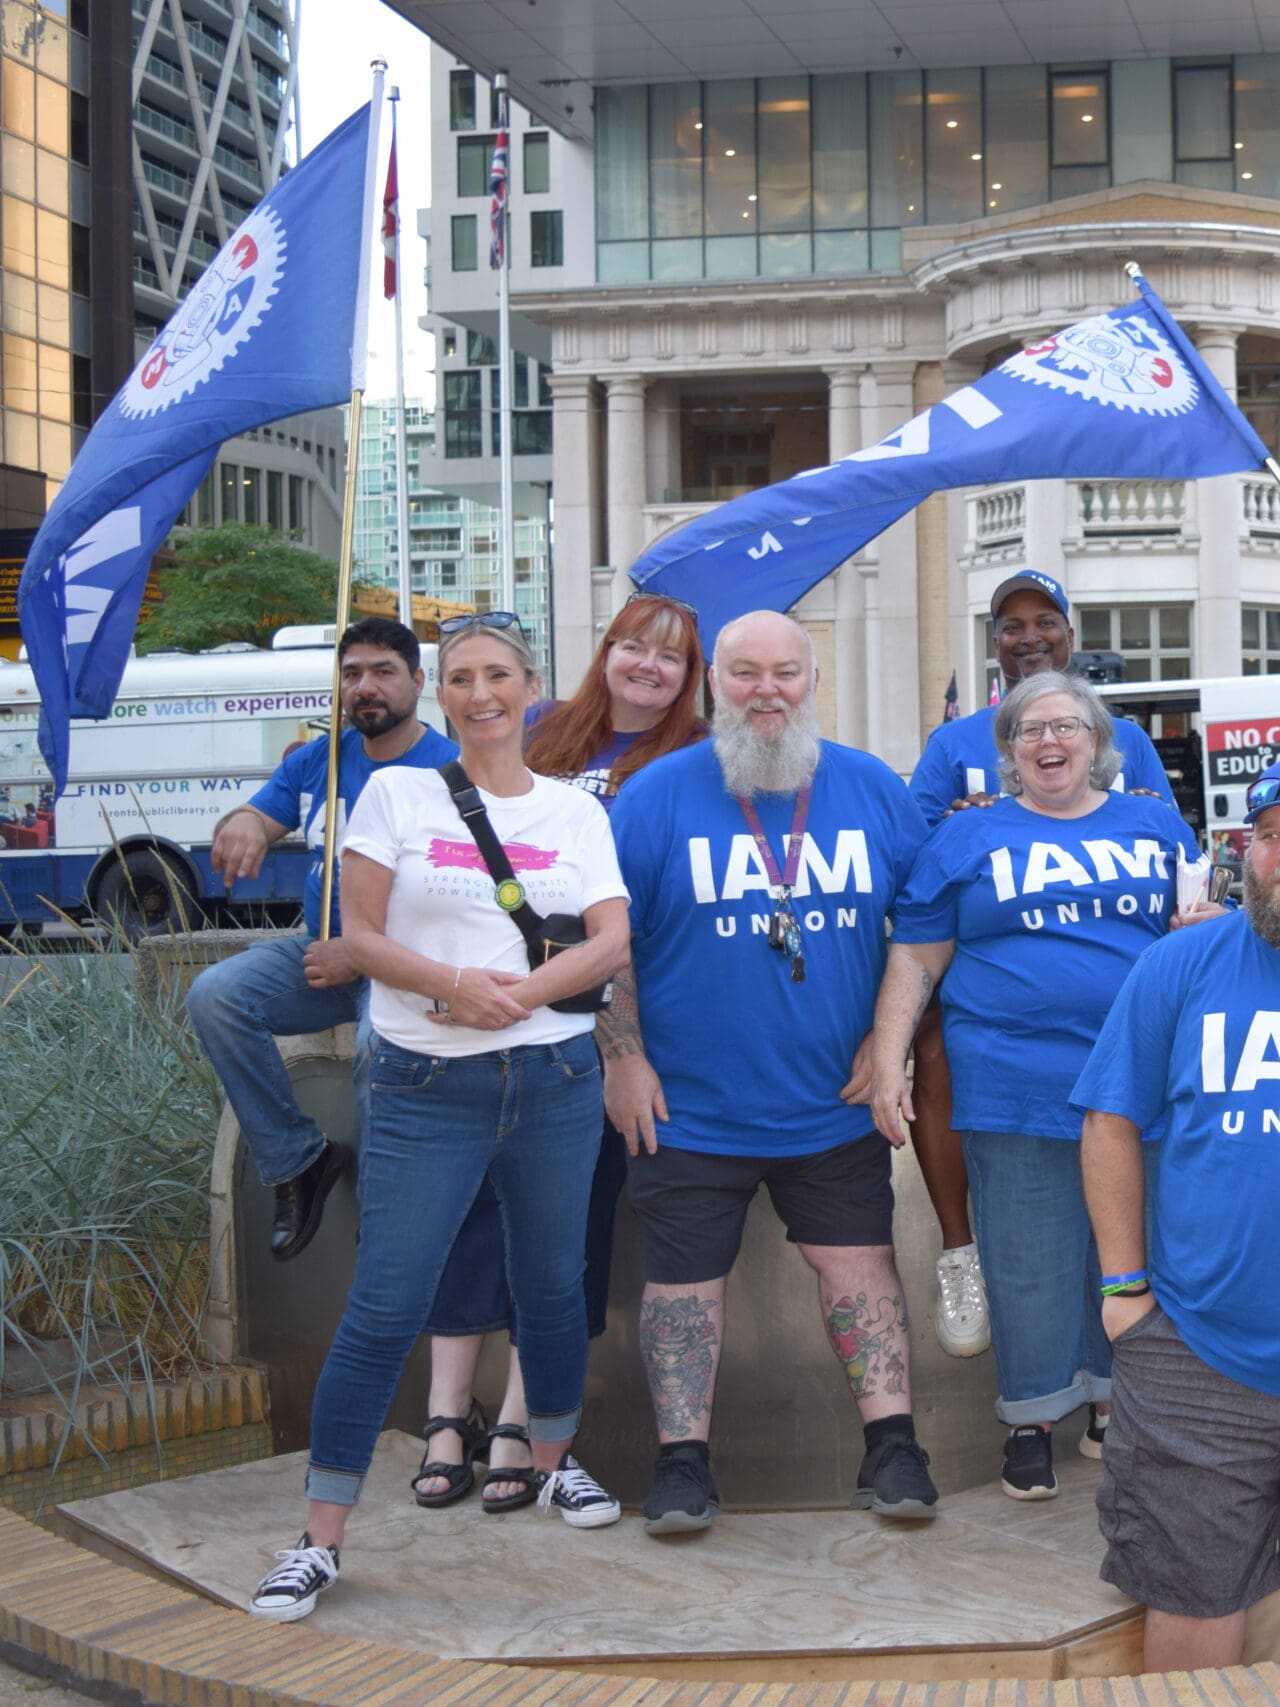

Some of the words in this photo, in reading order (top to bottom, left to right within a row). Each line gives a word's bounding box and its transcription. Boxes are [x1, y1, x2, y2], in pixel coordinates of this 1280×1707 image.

[108, 703, 148, 719] ore
[154, 696, 217, 716] watch
[1224, 729, 1261, 750] NO
[1257, 745, 1272, 756] to
[78, 783, 127, 797] FIND
[136, 780, 191, 795] YOUR
[201, 778, 243, 792] WAY
[688, 828, 873, 905] IAM
[989, 839, 1170, 903] IAM
[715, 907, 857, 937] UNON
[1020, 893, 1165, 931] UNION
